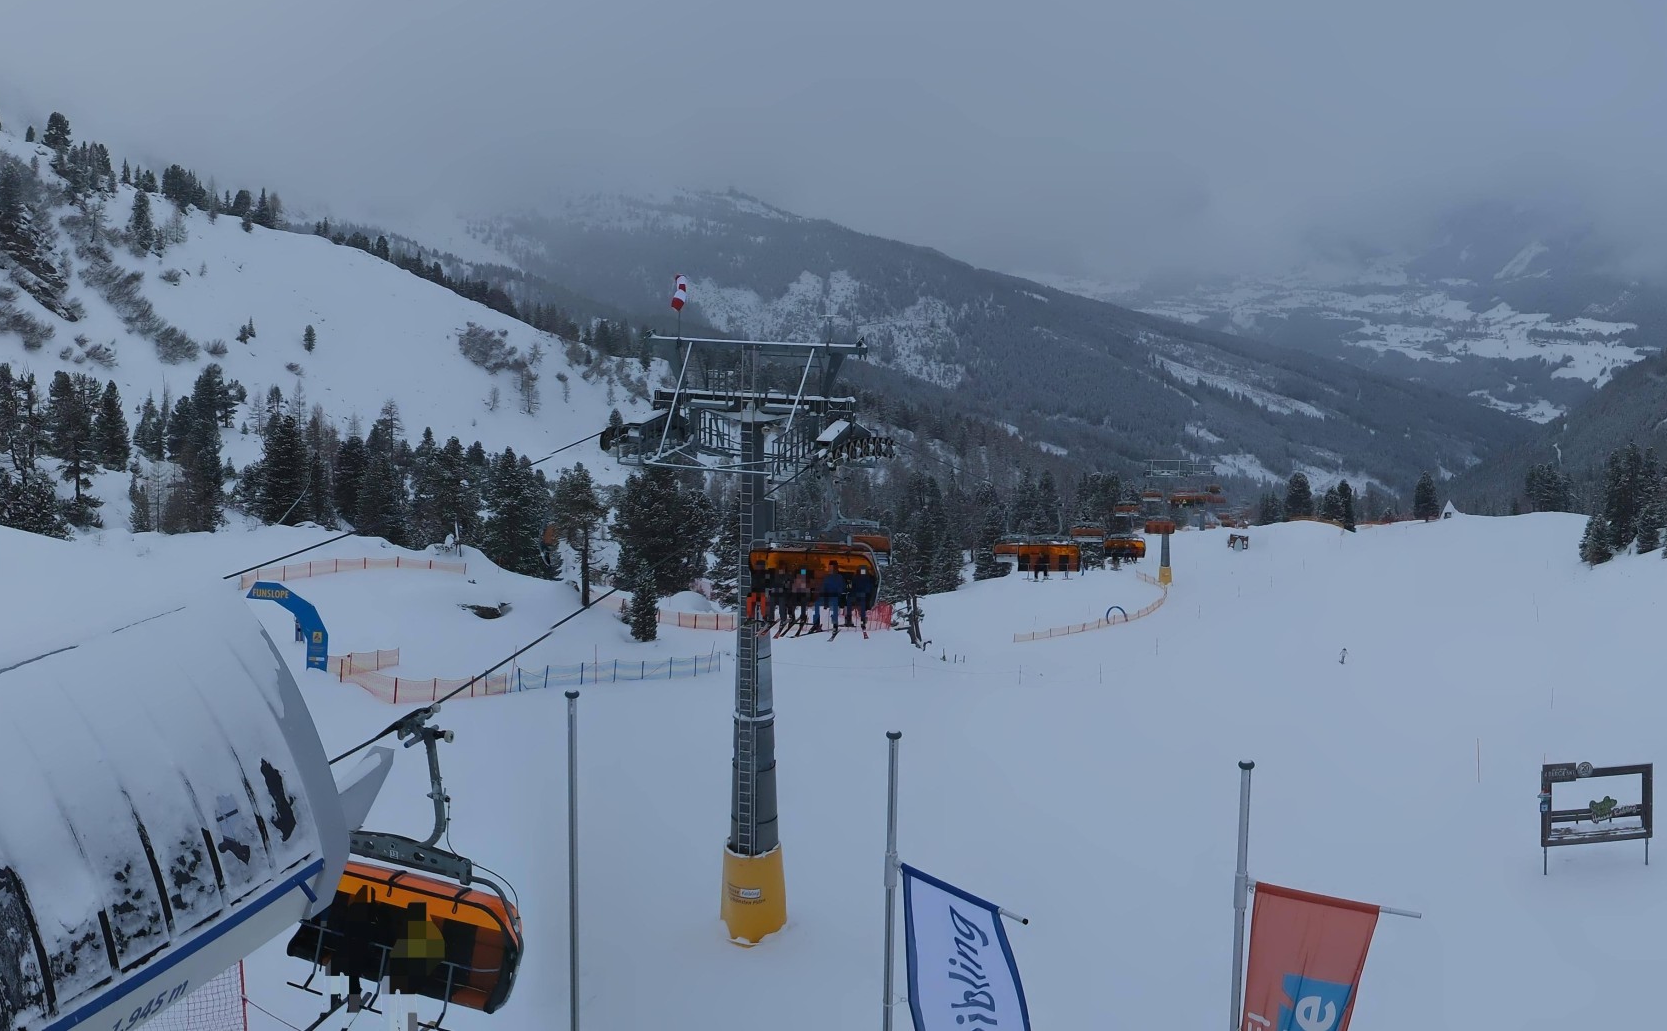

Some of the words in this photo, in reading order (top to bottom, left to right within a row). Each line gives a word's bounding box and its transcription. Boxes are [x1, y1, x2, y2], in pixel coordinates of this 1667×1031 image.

[252, 589, 289, 599] FUNSLOPE
[948, 905, 998, 1031] ibling
[168, 980, 189, 1003] m
